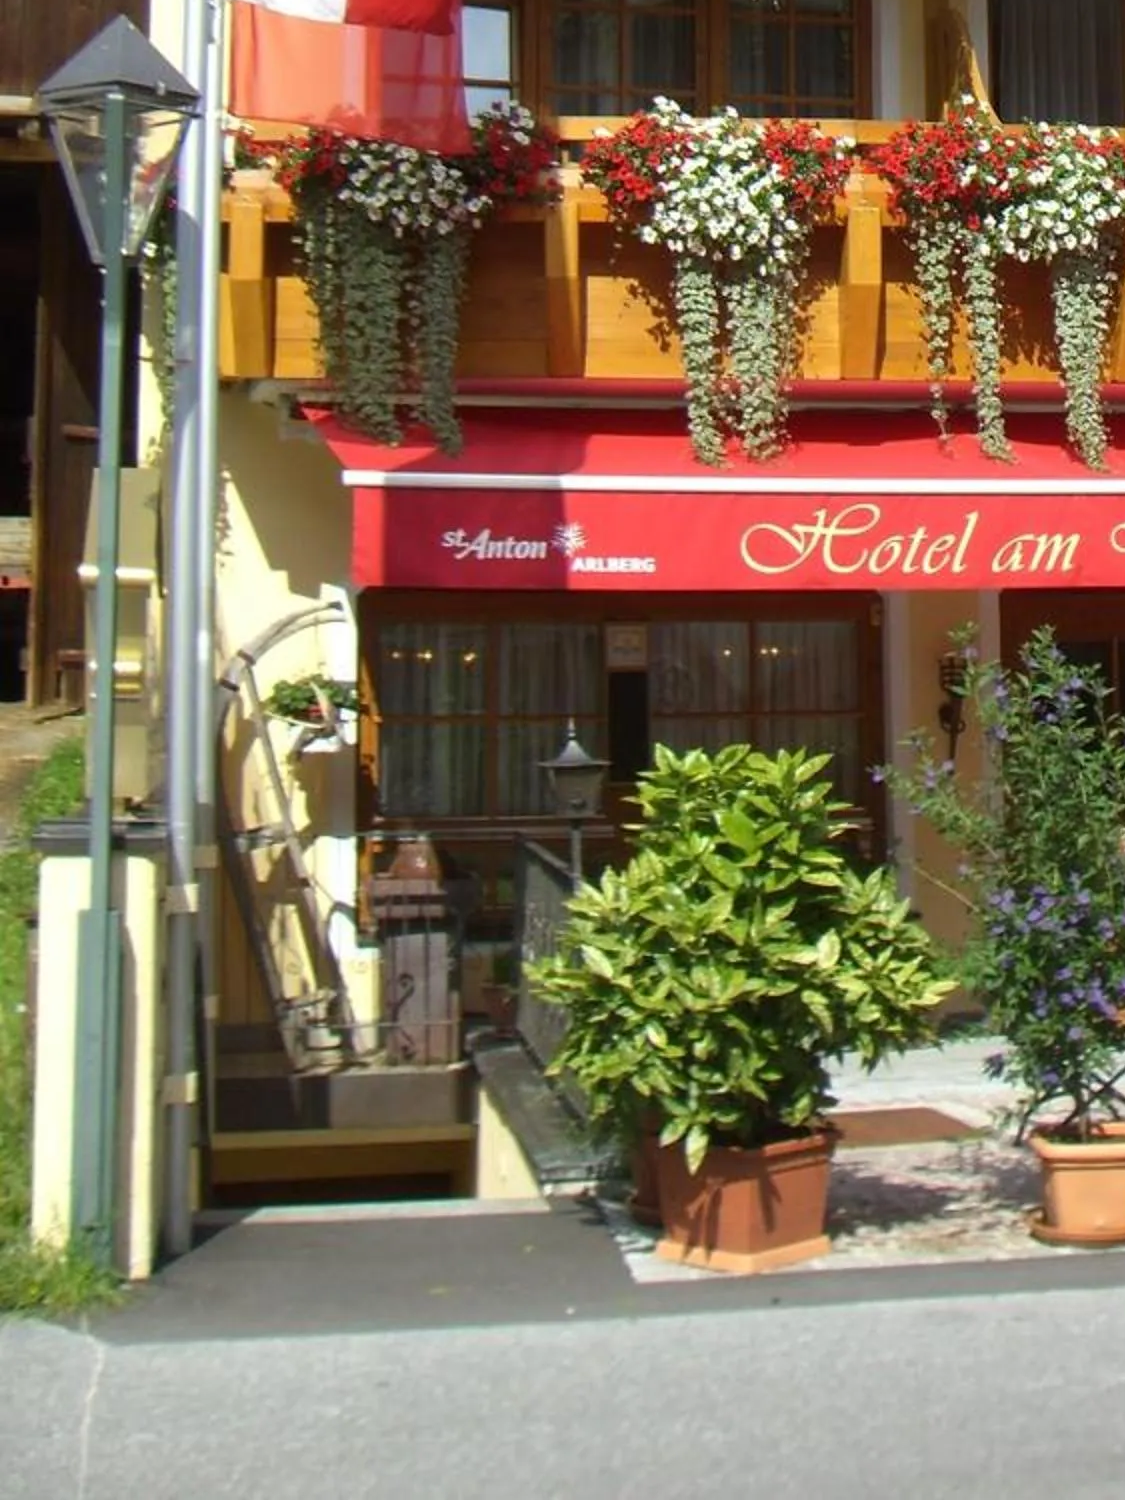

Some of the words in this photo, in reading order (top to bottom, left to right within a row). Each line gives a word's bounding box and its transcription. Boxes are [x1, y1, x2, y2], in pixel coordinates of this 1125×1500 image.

[740, 503, 979, 575] Hotel
[991, 533, 1081, 574] am
[571, 556, 657, 573] ARLBERG
